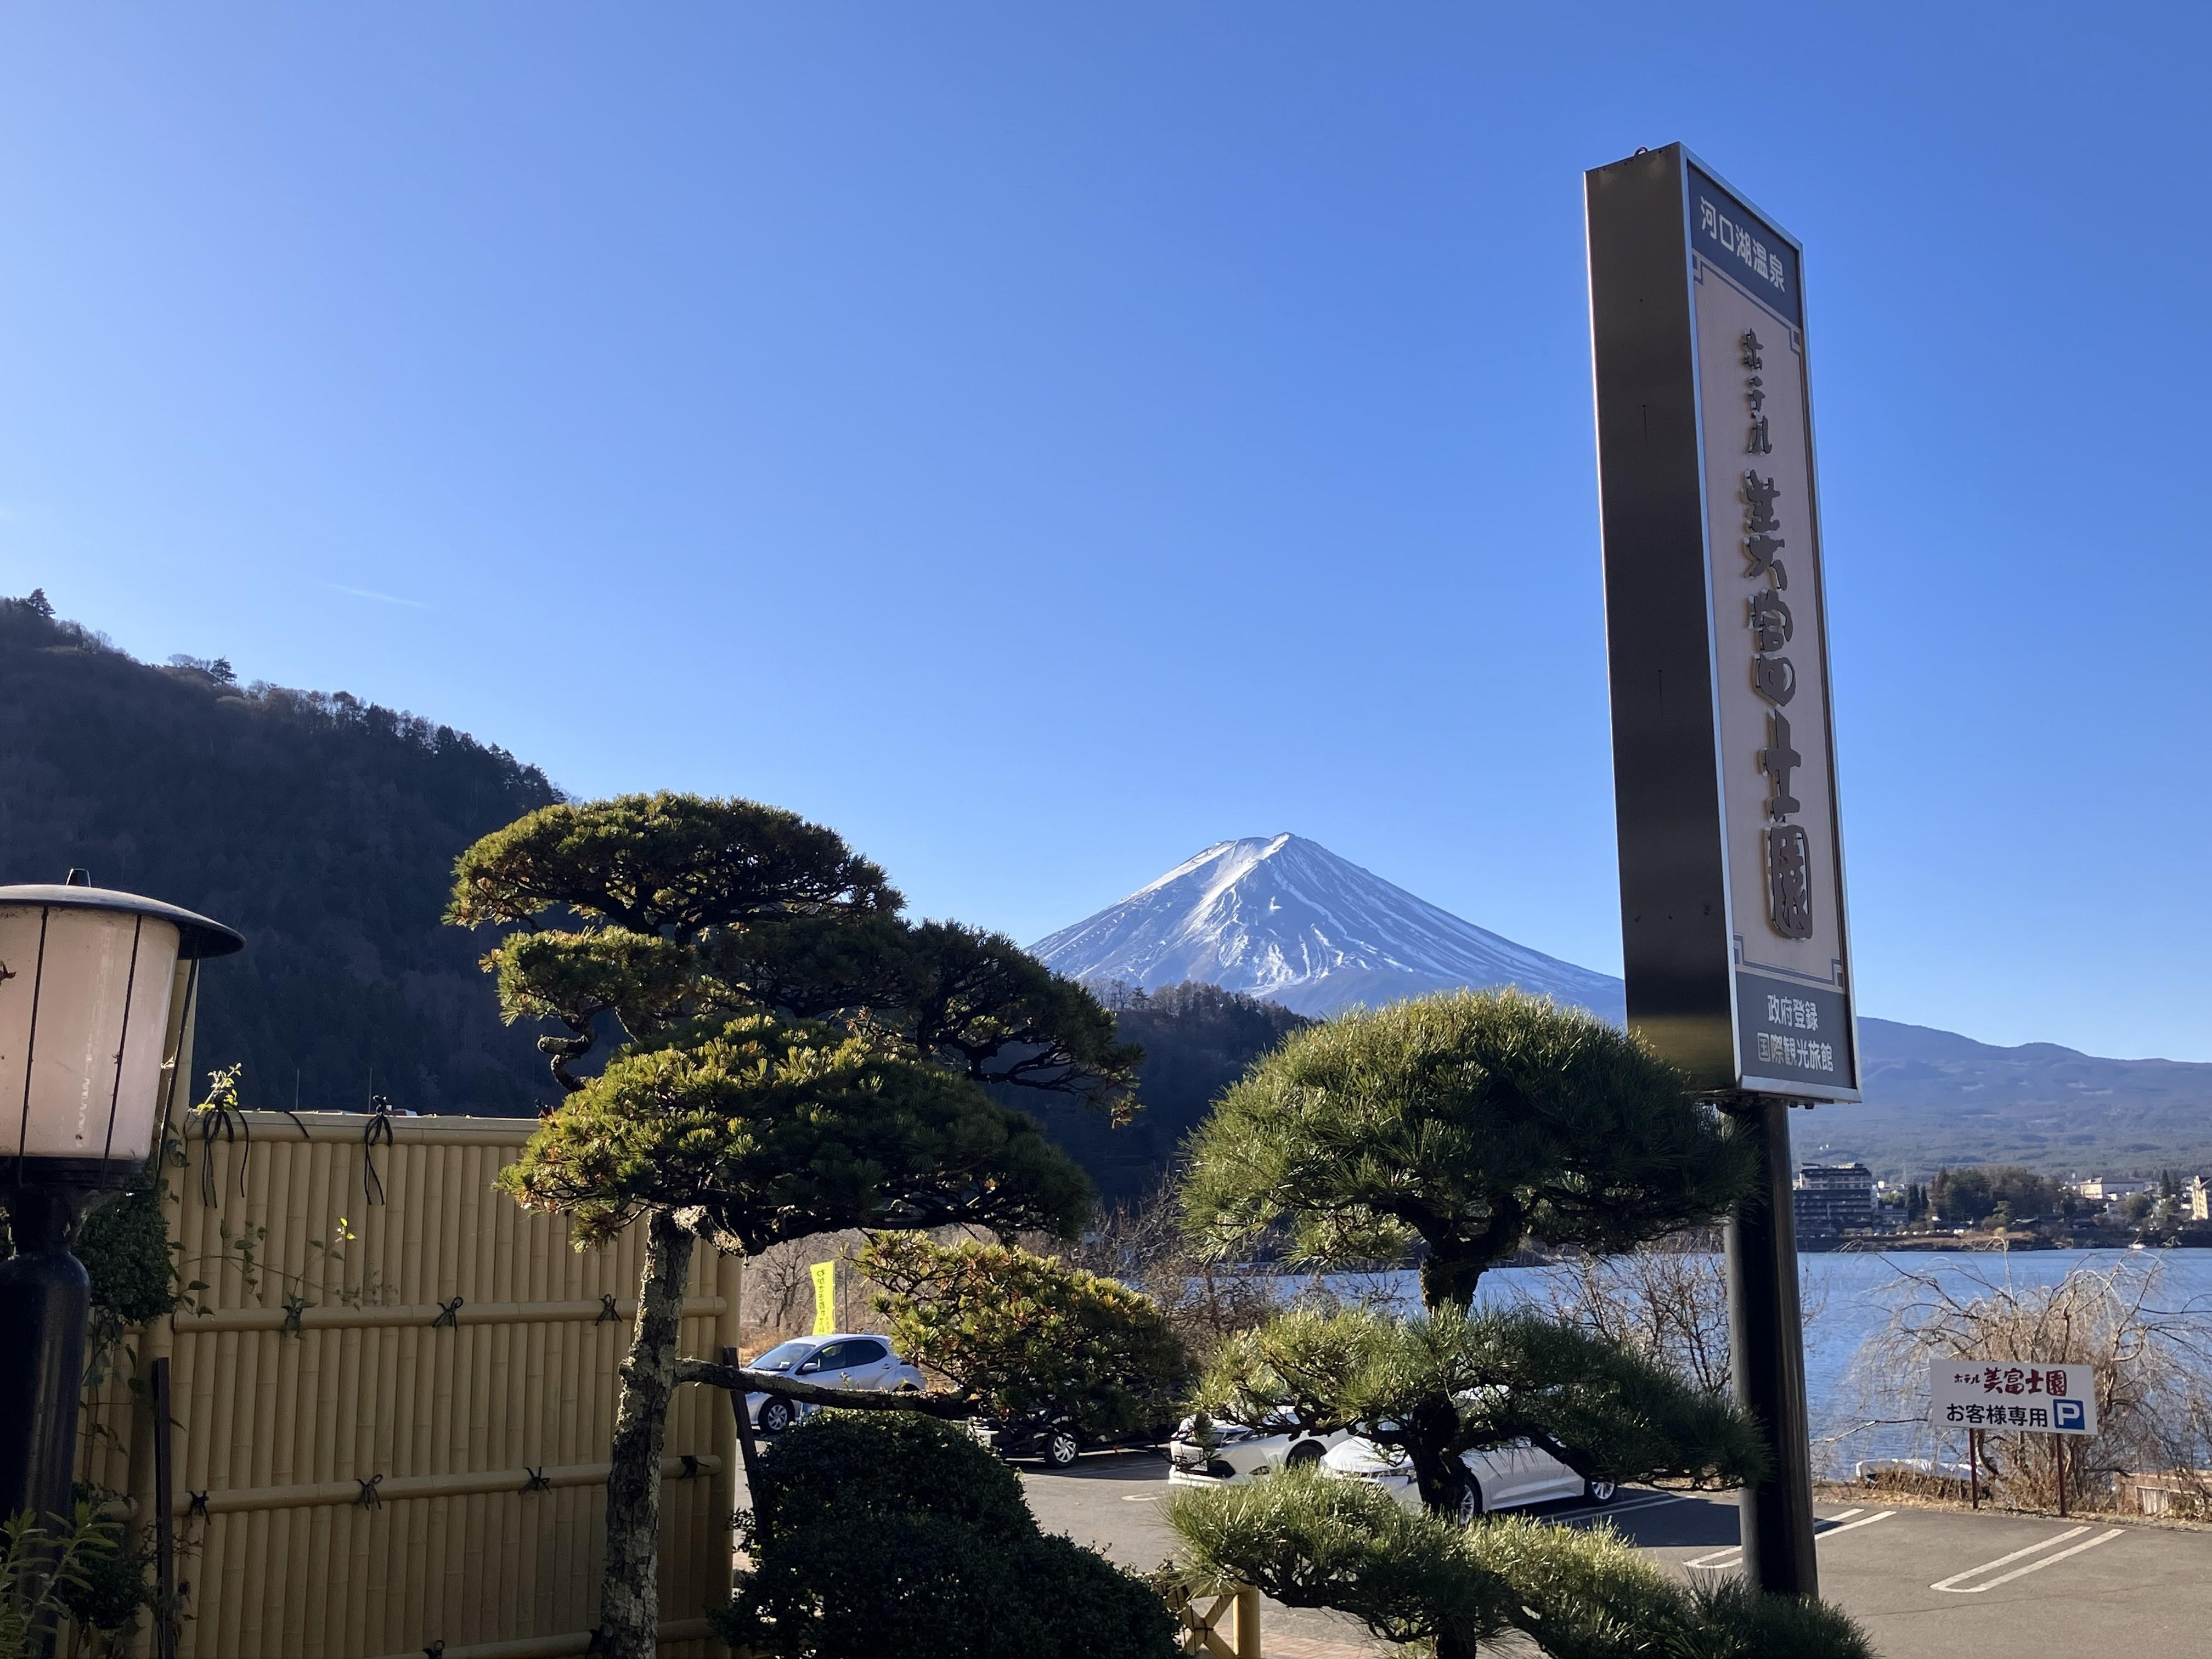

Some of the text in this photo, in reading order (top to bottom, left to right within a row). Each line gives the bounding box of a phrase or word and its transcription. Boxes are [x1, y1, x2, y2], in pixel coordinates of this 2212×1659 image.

[1700, 196, 1786, 293] 河口湖温泉
[1767, 994, 1819, 1031] 政府登録
[1757, 1032, 1833, 1072] 国際観光旅館
[1946, 1402, 2080, 1427] お客様専用 P
